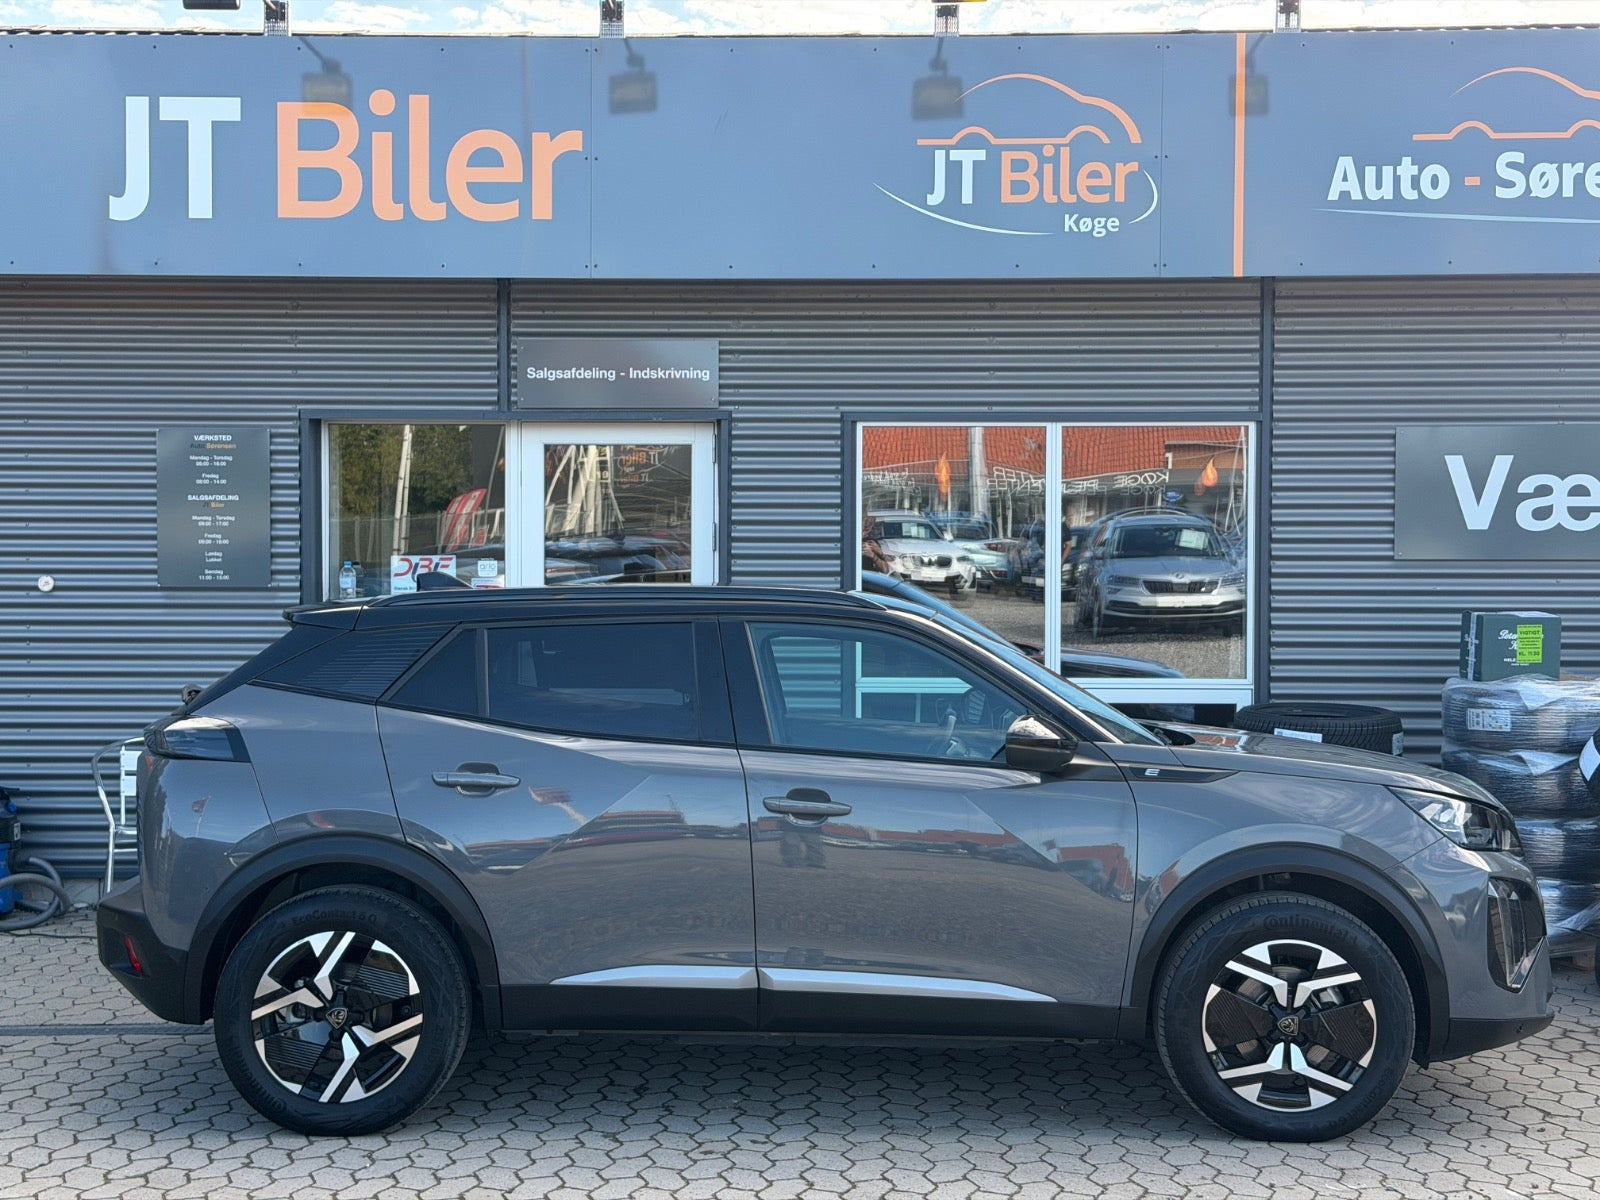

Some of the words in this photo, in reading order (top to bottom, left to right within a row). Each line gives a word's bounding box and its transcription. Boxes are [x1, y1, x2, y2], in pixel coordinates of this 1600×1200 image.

[109, 96, 241, 220] JT
[277, 89, 583, 221] Biler
[926, 149, 986, 206] JT
[1001, 145, 1139, 204] Biler
[1327, 156, 1451, 201] Auto
[1064, 213, 1120, 237] Køge
[526, 367, 616, 382] Salgsafdeling
[629, 367, 711, 382] Indskrivning
[1444, 454, 1600, 532] Væ
